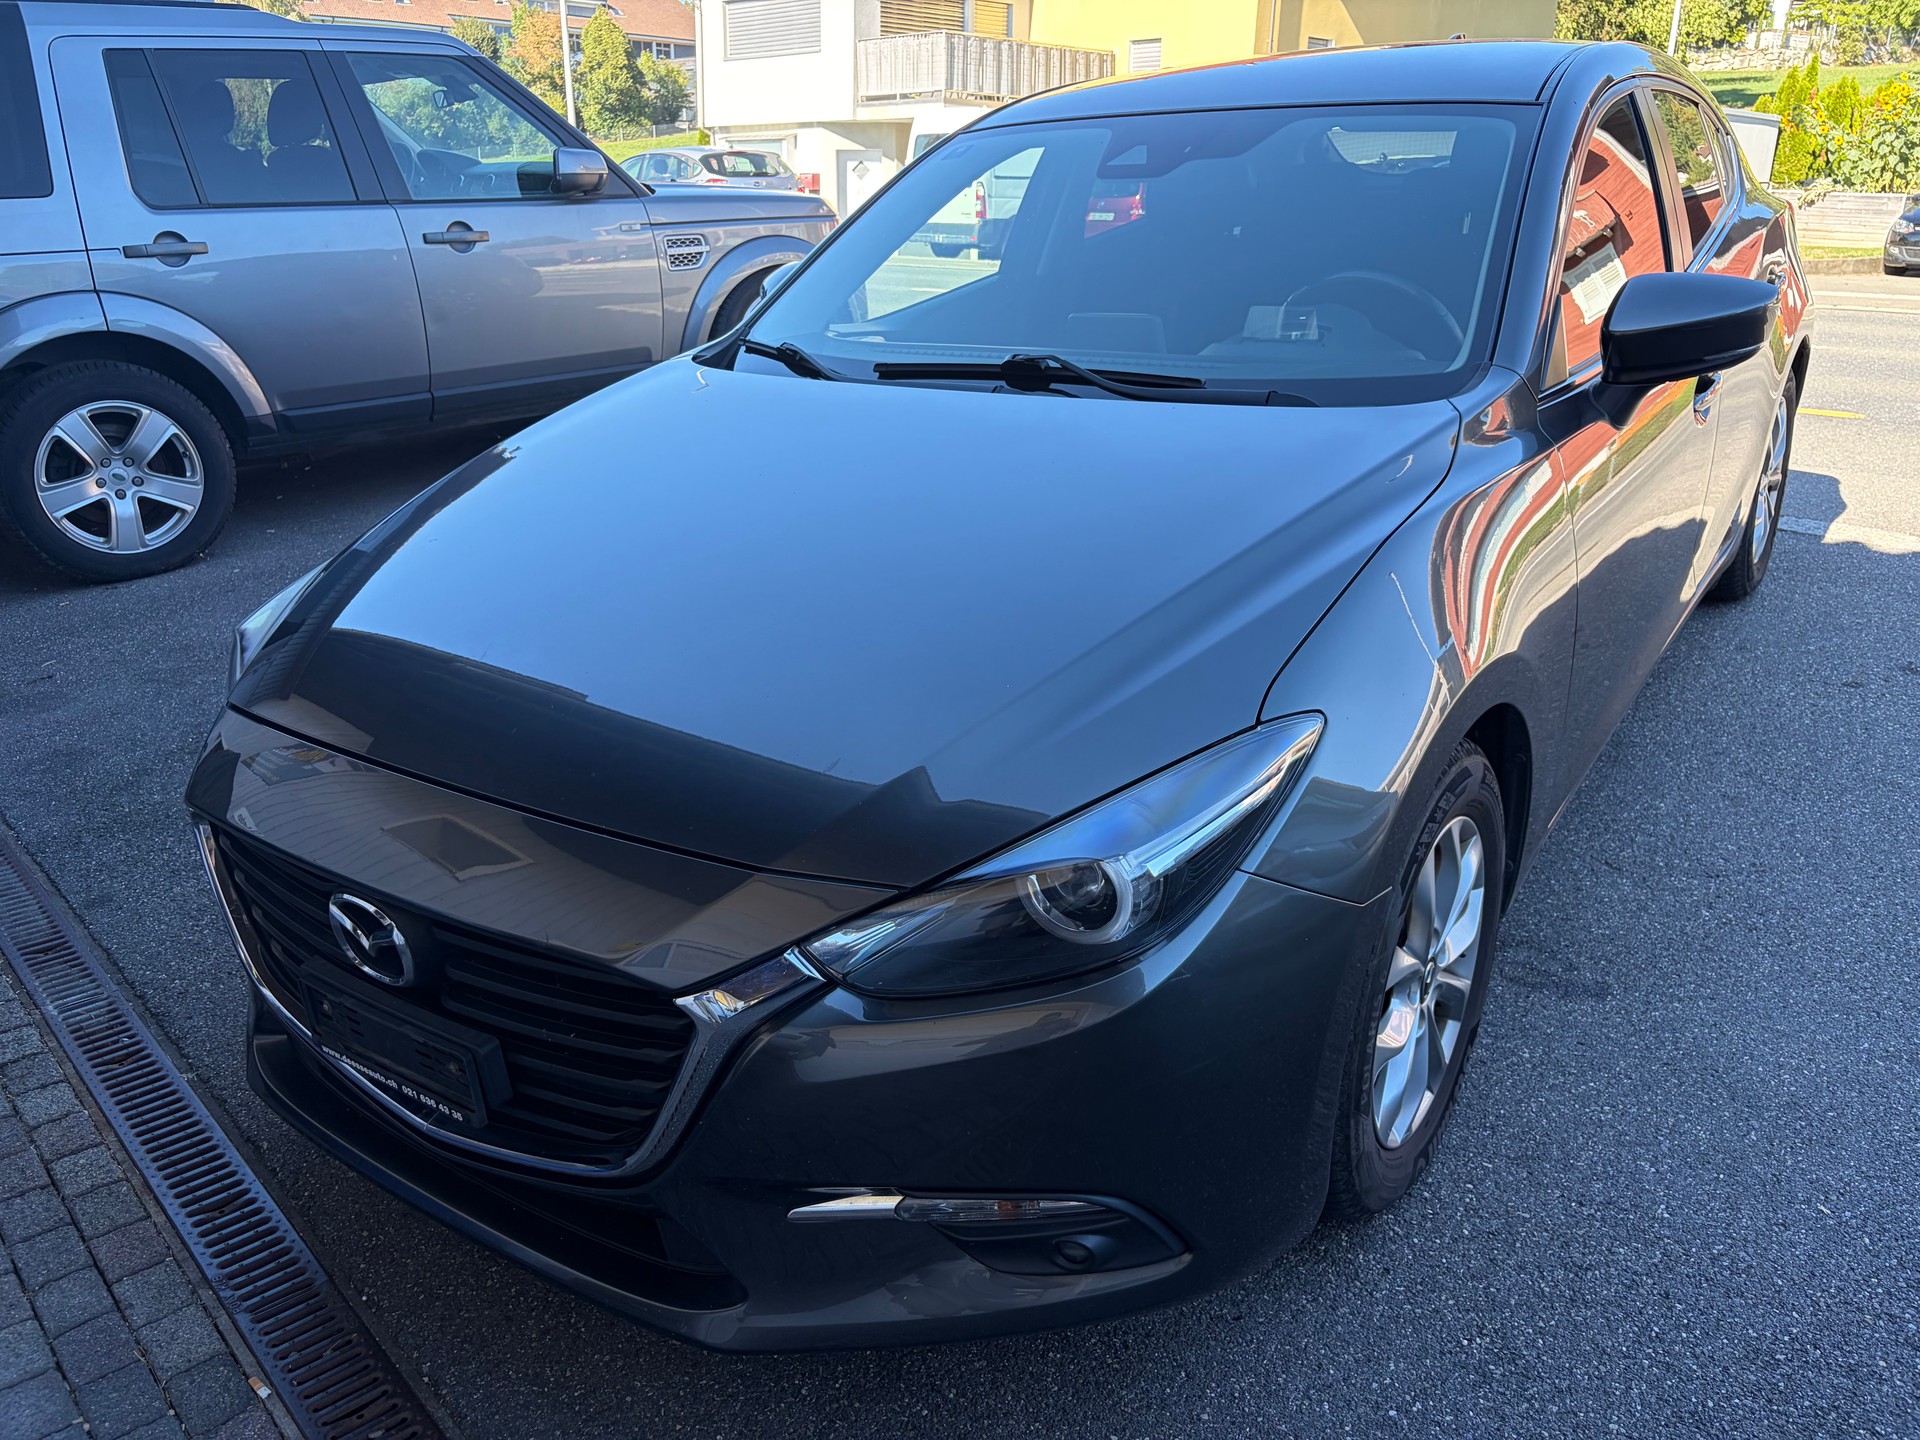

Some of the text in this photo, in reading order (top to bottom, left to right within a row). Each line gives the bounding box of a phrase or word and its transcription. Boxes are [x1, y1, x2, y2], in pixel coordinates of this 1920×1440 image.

[401, 1085, 418, 1099] 021
[419, 1094, 437, 1108] 636
[438, 1103, 450, 1115] 43
[451, 1110, 464, 1121] 35
